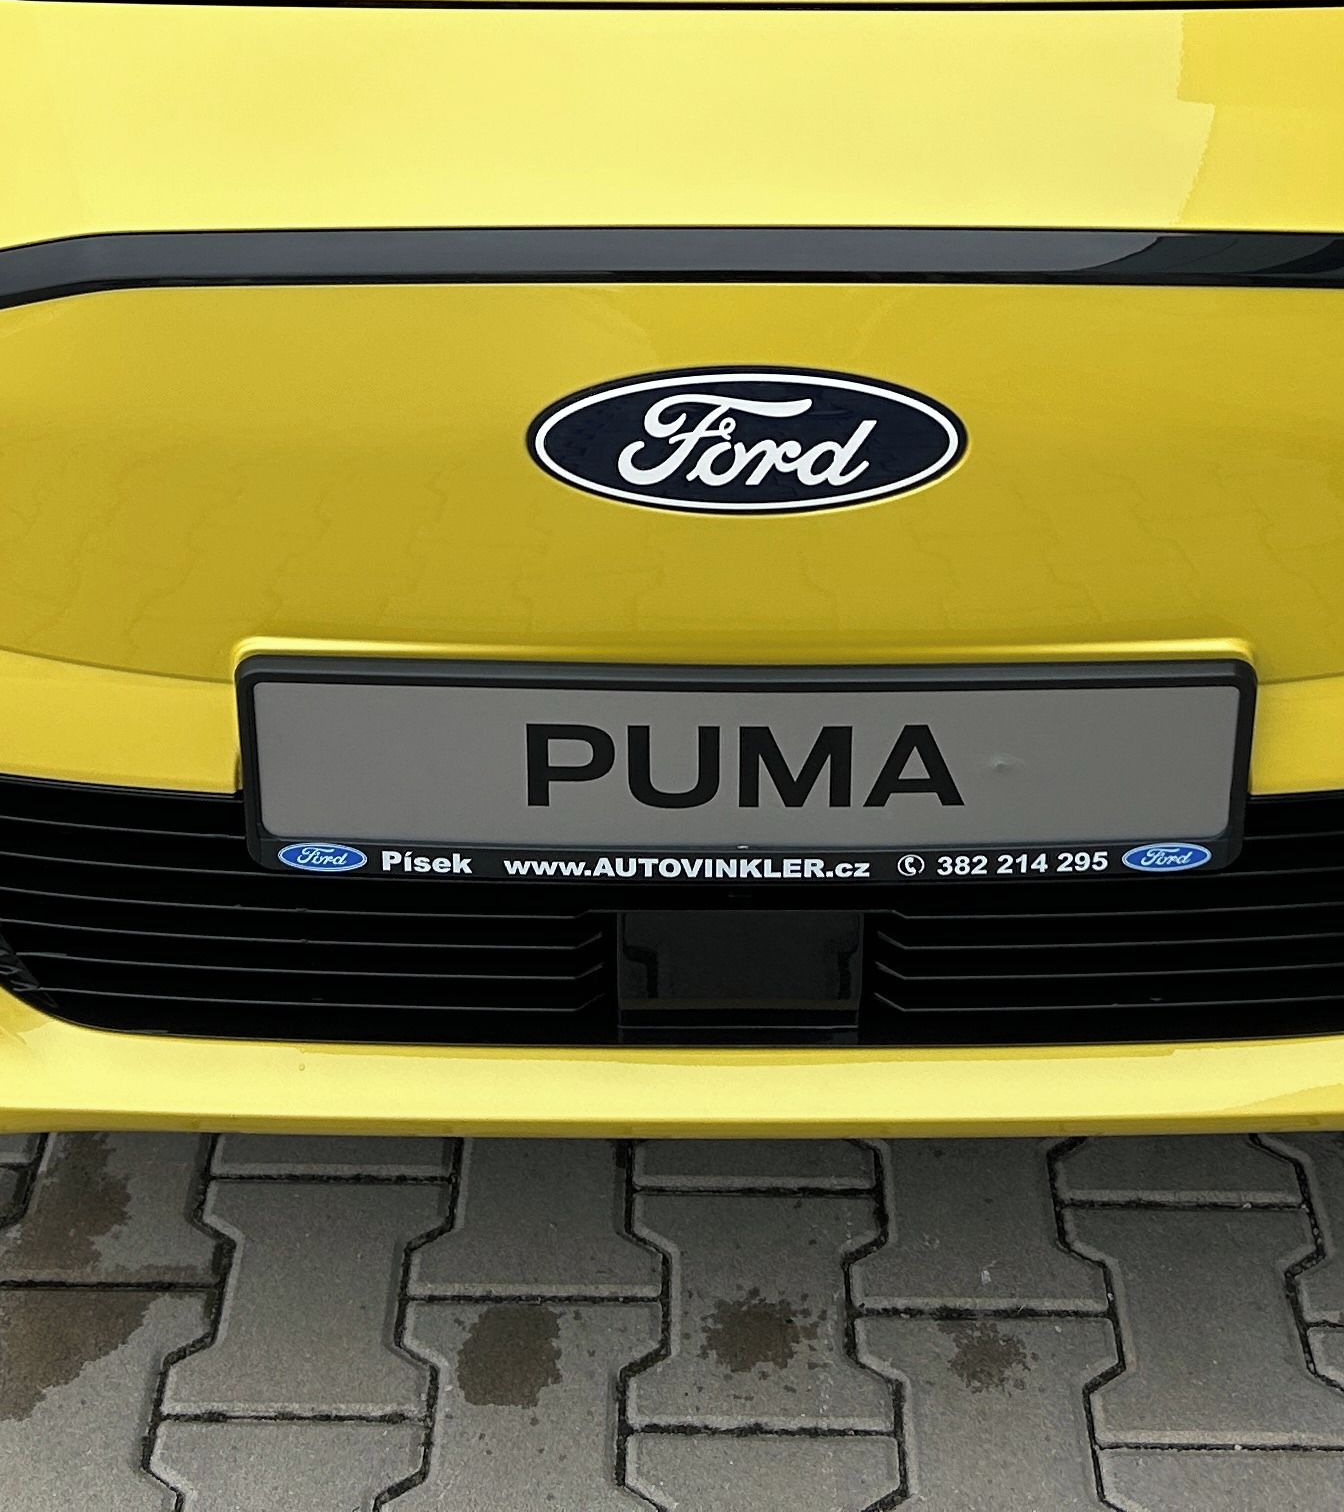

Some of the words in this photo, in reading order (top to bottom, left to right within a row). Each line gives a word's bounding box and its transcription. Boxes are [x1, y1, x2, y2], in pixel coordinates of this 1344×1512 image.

[617, 392, 878, 487] Ford
[525, 722, 966, 809] PUMA
[296, 845, 349, 867] Ford
[381, 851, 473, 874] Písek
[504, 857, 871, 879] www.AUTOVINKLER.cz
[936, 855, 988, 876] 382
[996, 853, 1048, 875] 214
[1056, 851, 1109, 873] 295
[1140, 847, 1193, 867] Ford
